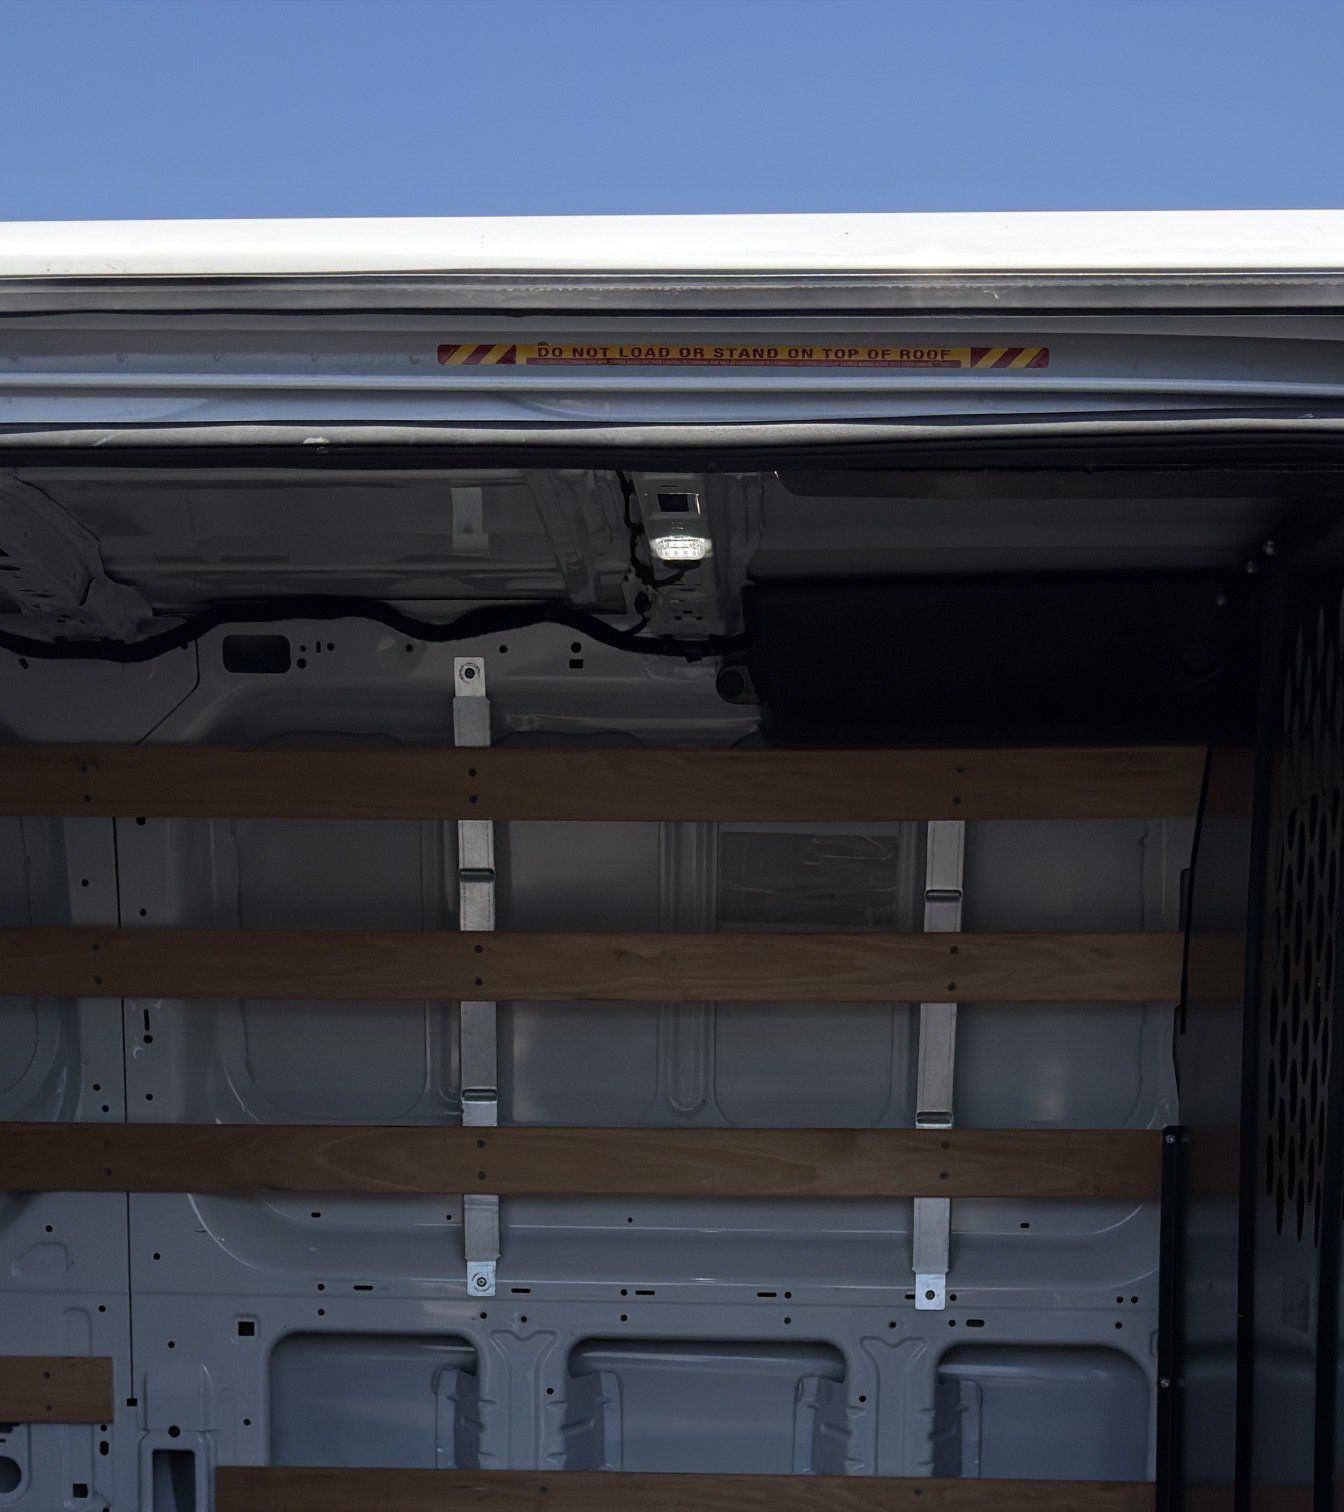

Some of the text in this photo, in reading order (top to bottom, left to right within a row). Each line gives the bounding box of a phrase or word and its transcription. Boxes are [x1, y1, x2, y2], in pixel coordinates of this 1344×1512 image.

[538, 348, 950, 360] DO NOT LOAD OR STAND ON TOP OF ROOF
